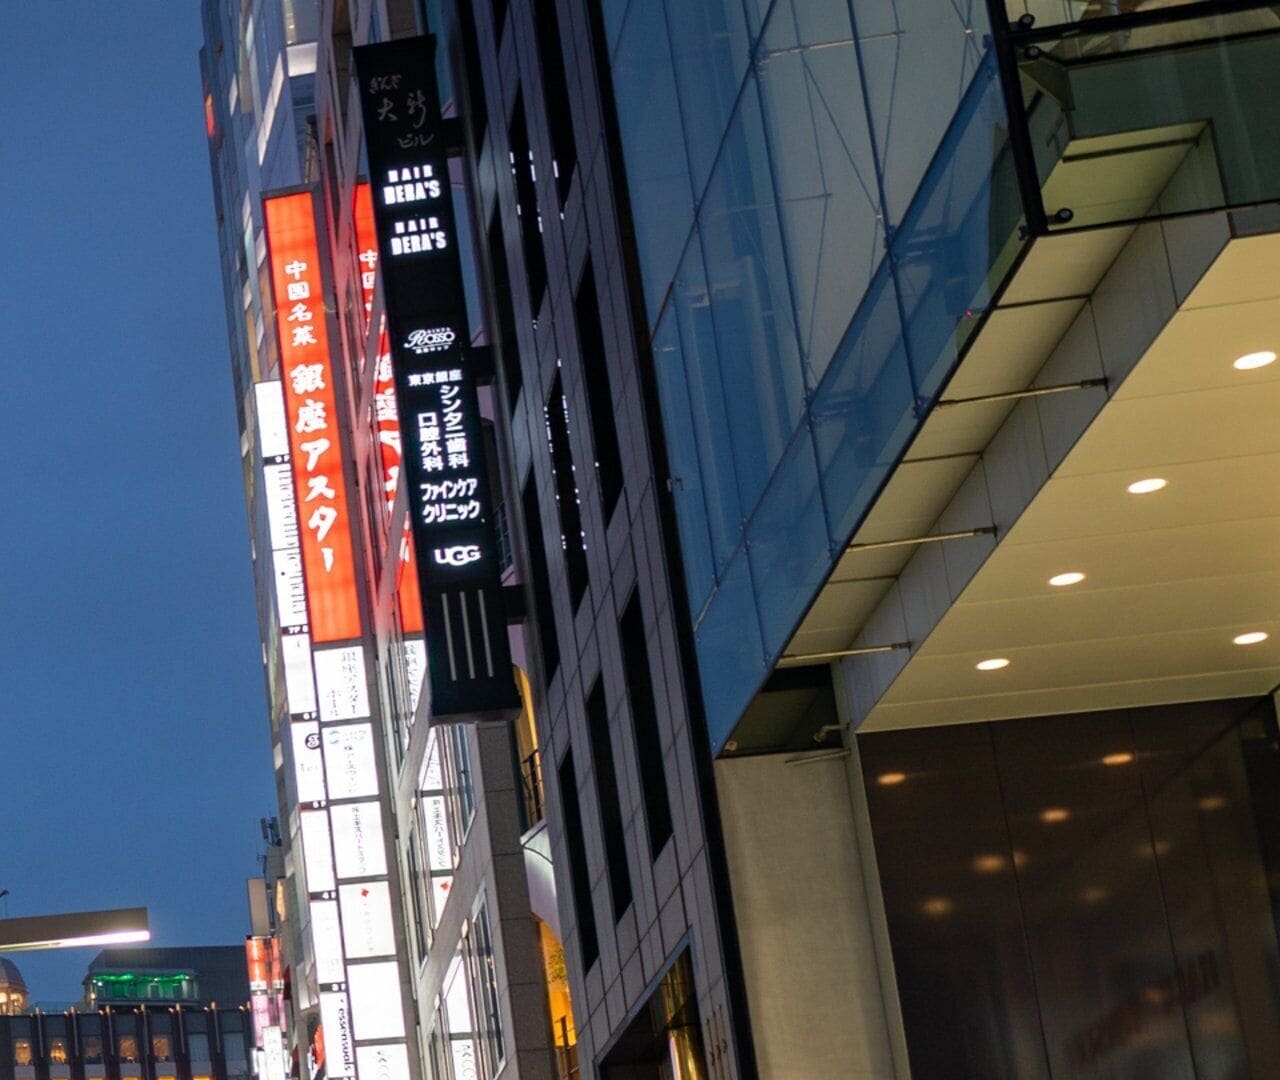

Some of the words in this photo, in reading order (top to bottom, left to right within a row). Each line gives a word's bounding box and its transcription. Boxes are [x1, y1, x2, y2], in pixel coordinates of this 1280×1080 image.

[388, 165, 433, 183] HAIR
[394, 217, 439, 234] HAIR
[285, 260, 317, 347] 中国名菜
[290, 363, 338, 573] 銀座アスター
[420, 478, 478, 501] ファインケア
[423, 500, 481, 523] クリニック
[434, 545, 481, 566] UGG
